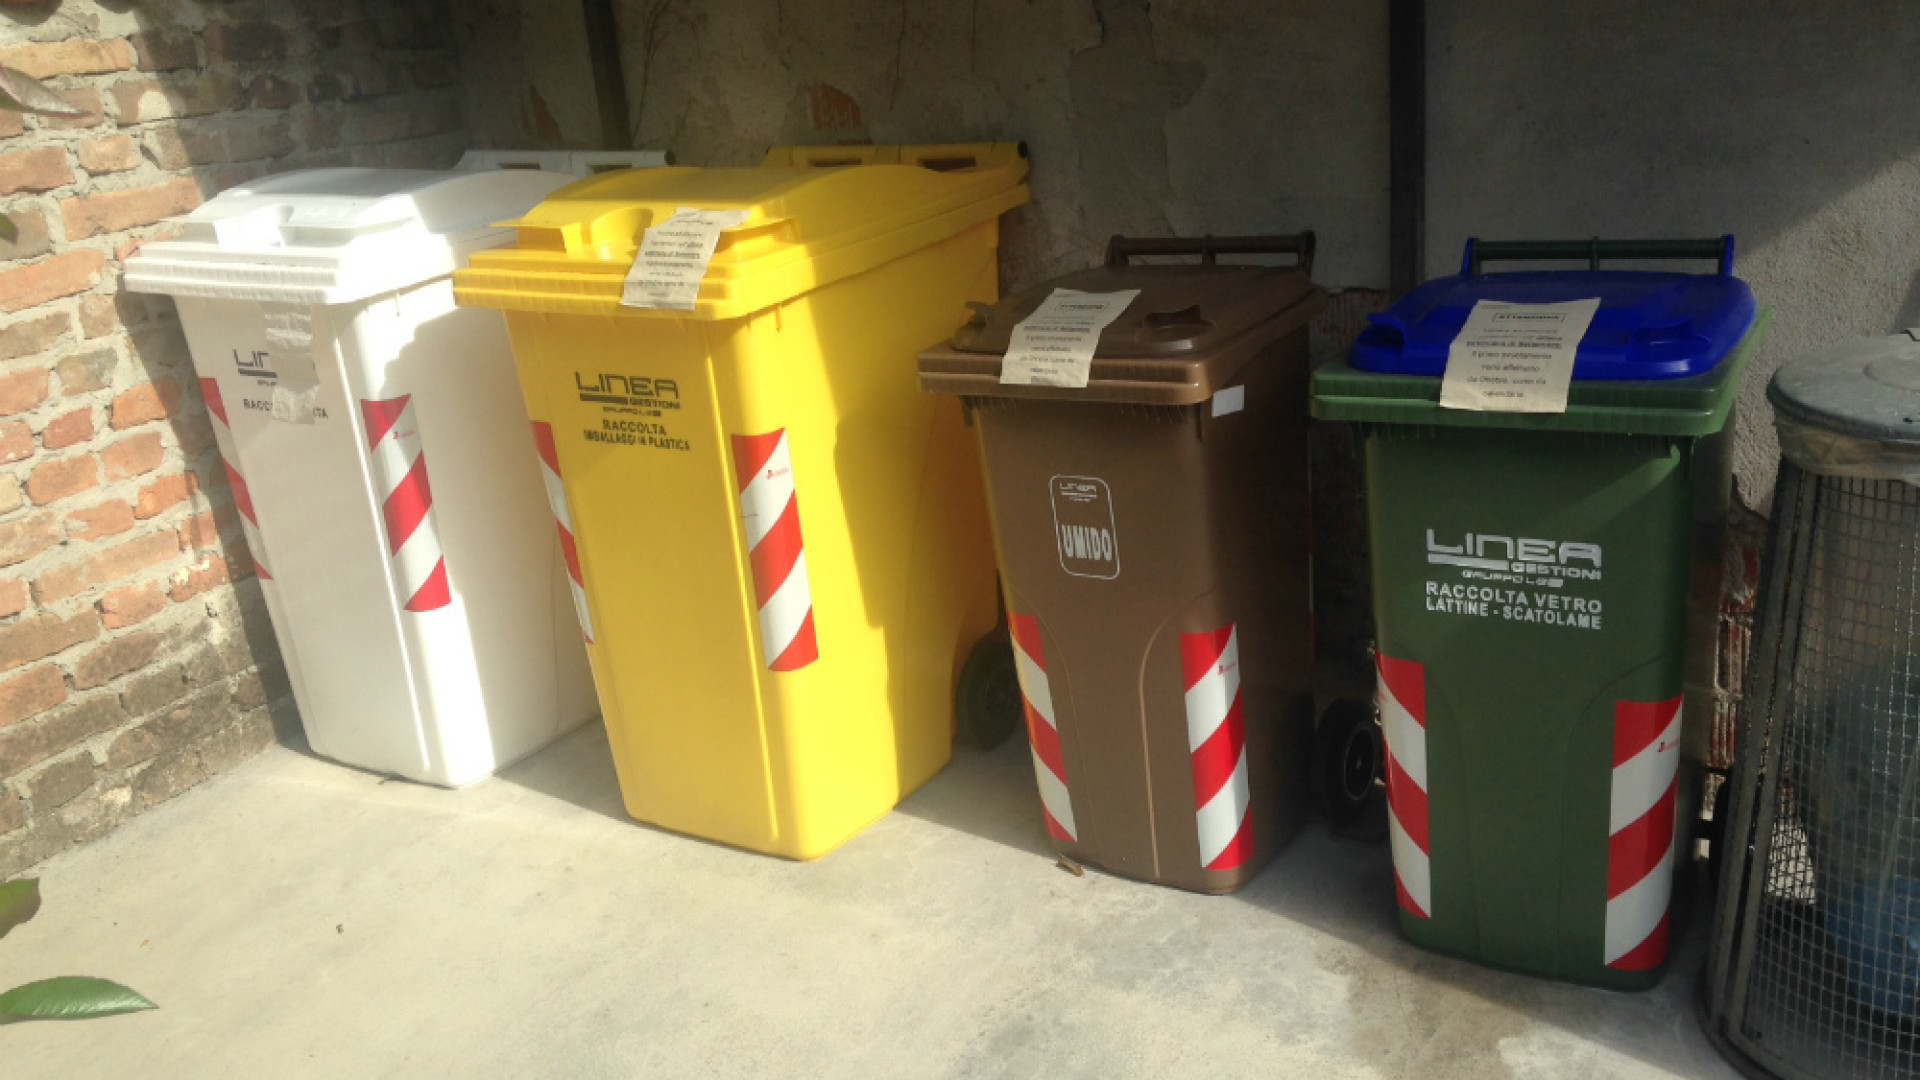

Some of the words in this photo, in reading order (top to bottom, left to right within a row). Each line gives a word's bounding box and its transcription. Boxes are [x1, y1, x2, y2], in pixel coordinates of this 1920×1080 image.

[575, 370, 680, 399] LINEA
[602, 419, 667, 437] RACCOLTA
[648, 435, 691, 452] PLASTICA
[1061, 524, 1113, 562] UMIDO
[1426, 528, 1602, 567] LINEA
[1511, 561, 1601, 580] GESTIONI
[1426, 581, 1529, 606] RACCOLTA
[1534, 592, 1602, 613] VETRO
[1426, 596, 1489, 617] LATTINE
[1503, 606, 1602, 630] SCATOLAME
